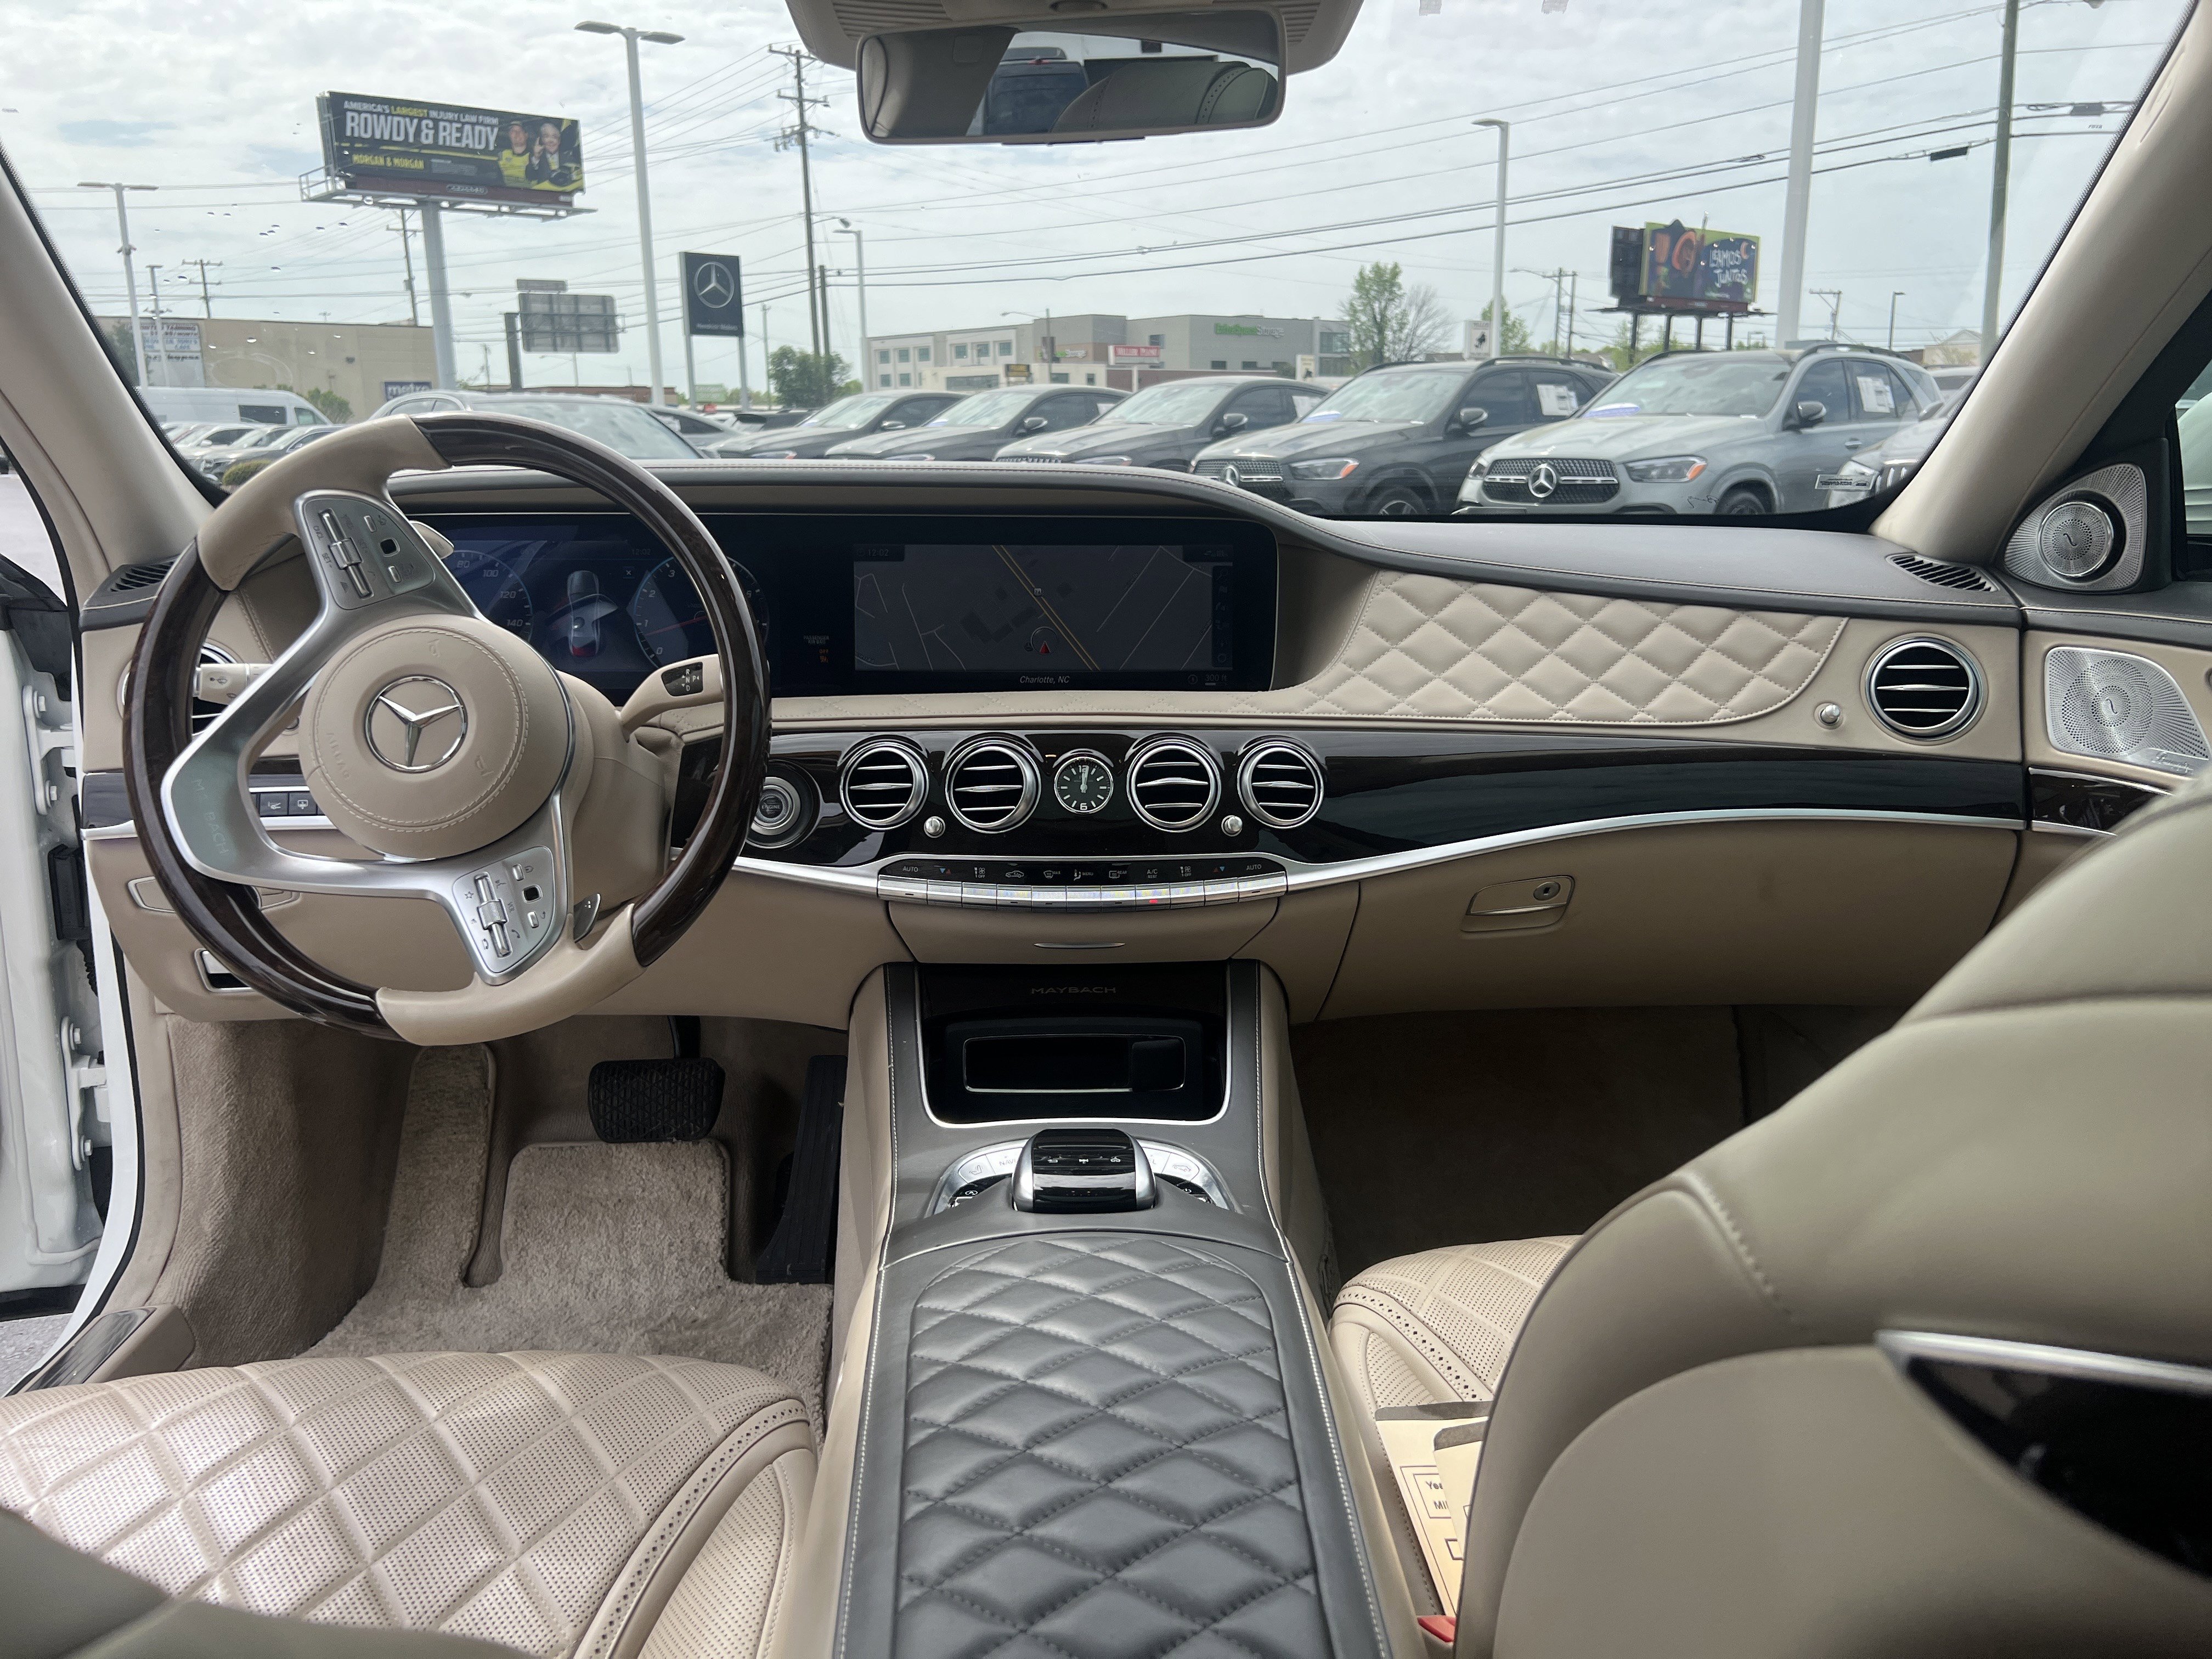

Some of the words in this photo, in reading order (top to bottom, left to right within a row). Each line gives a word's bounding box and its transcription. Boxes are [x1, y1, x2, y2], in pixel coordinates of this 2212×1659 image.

[343, 100, 390, 113] AMERICA'S
[390, 106, 427, 117] LARGEST
[429, 110, 459, 121] INJURY
[460, 113, 477, 122] LAW
[478, 116, 499, 125] FIRM
[345, 111, 419, 143] ROWDY
[420, 119, 435, 145] &
[438, 121, 499, 151] READY
[352, 154, 385, 166] MORGAN
[386, 156, 392, 167] &
[393, 157, 425, 170] MORGAN
[867, 549, 889, 557] 12:02
[456, 560, 470, 568] 80
[668, 569, 675, 578] 3
[506, 619, 523, 627] 140
[656, 647, 663, 655] 0
[1020, 675, 1056, 684] Charlotte,
